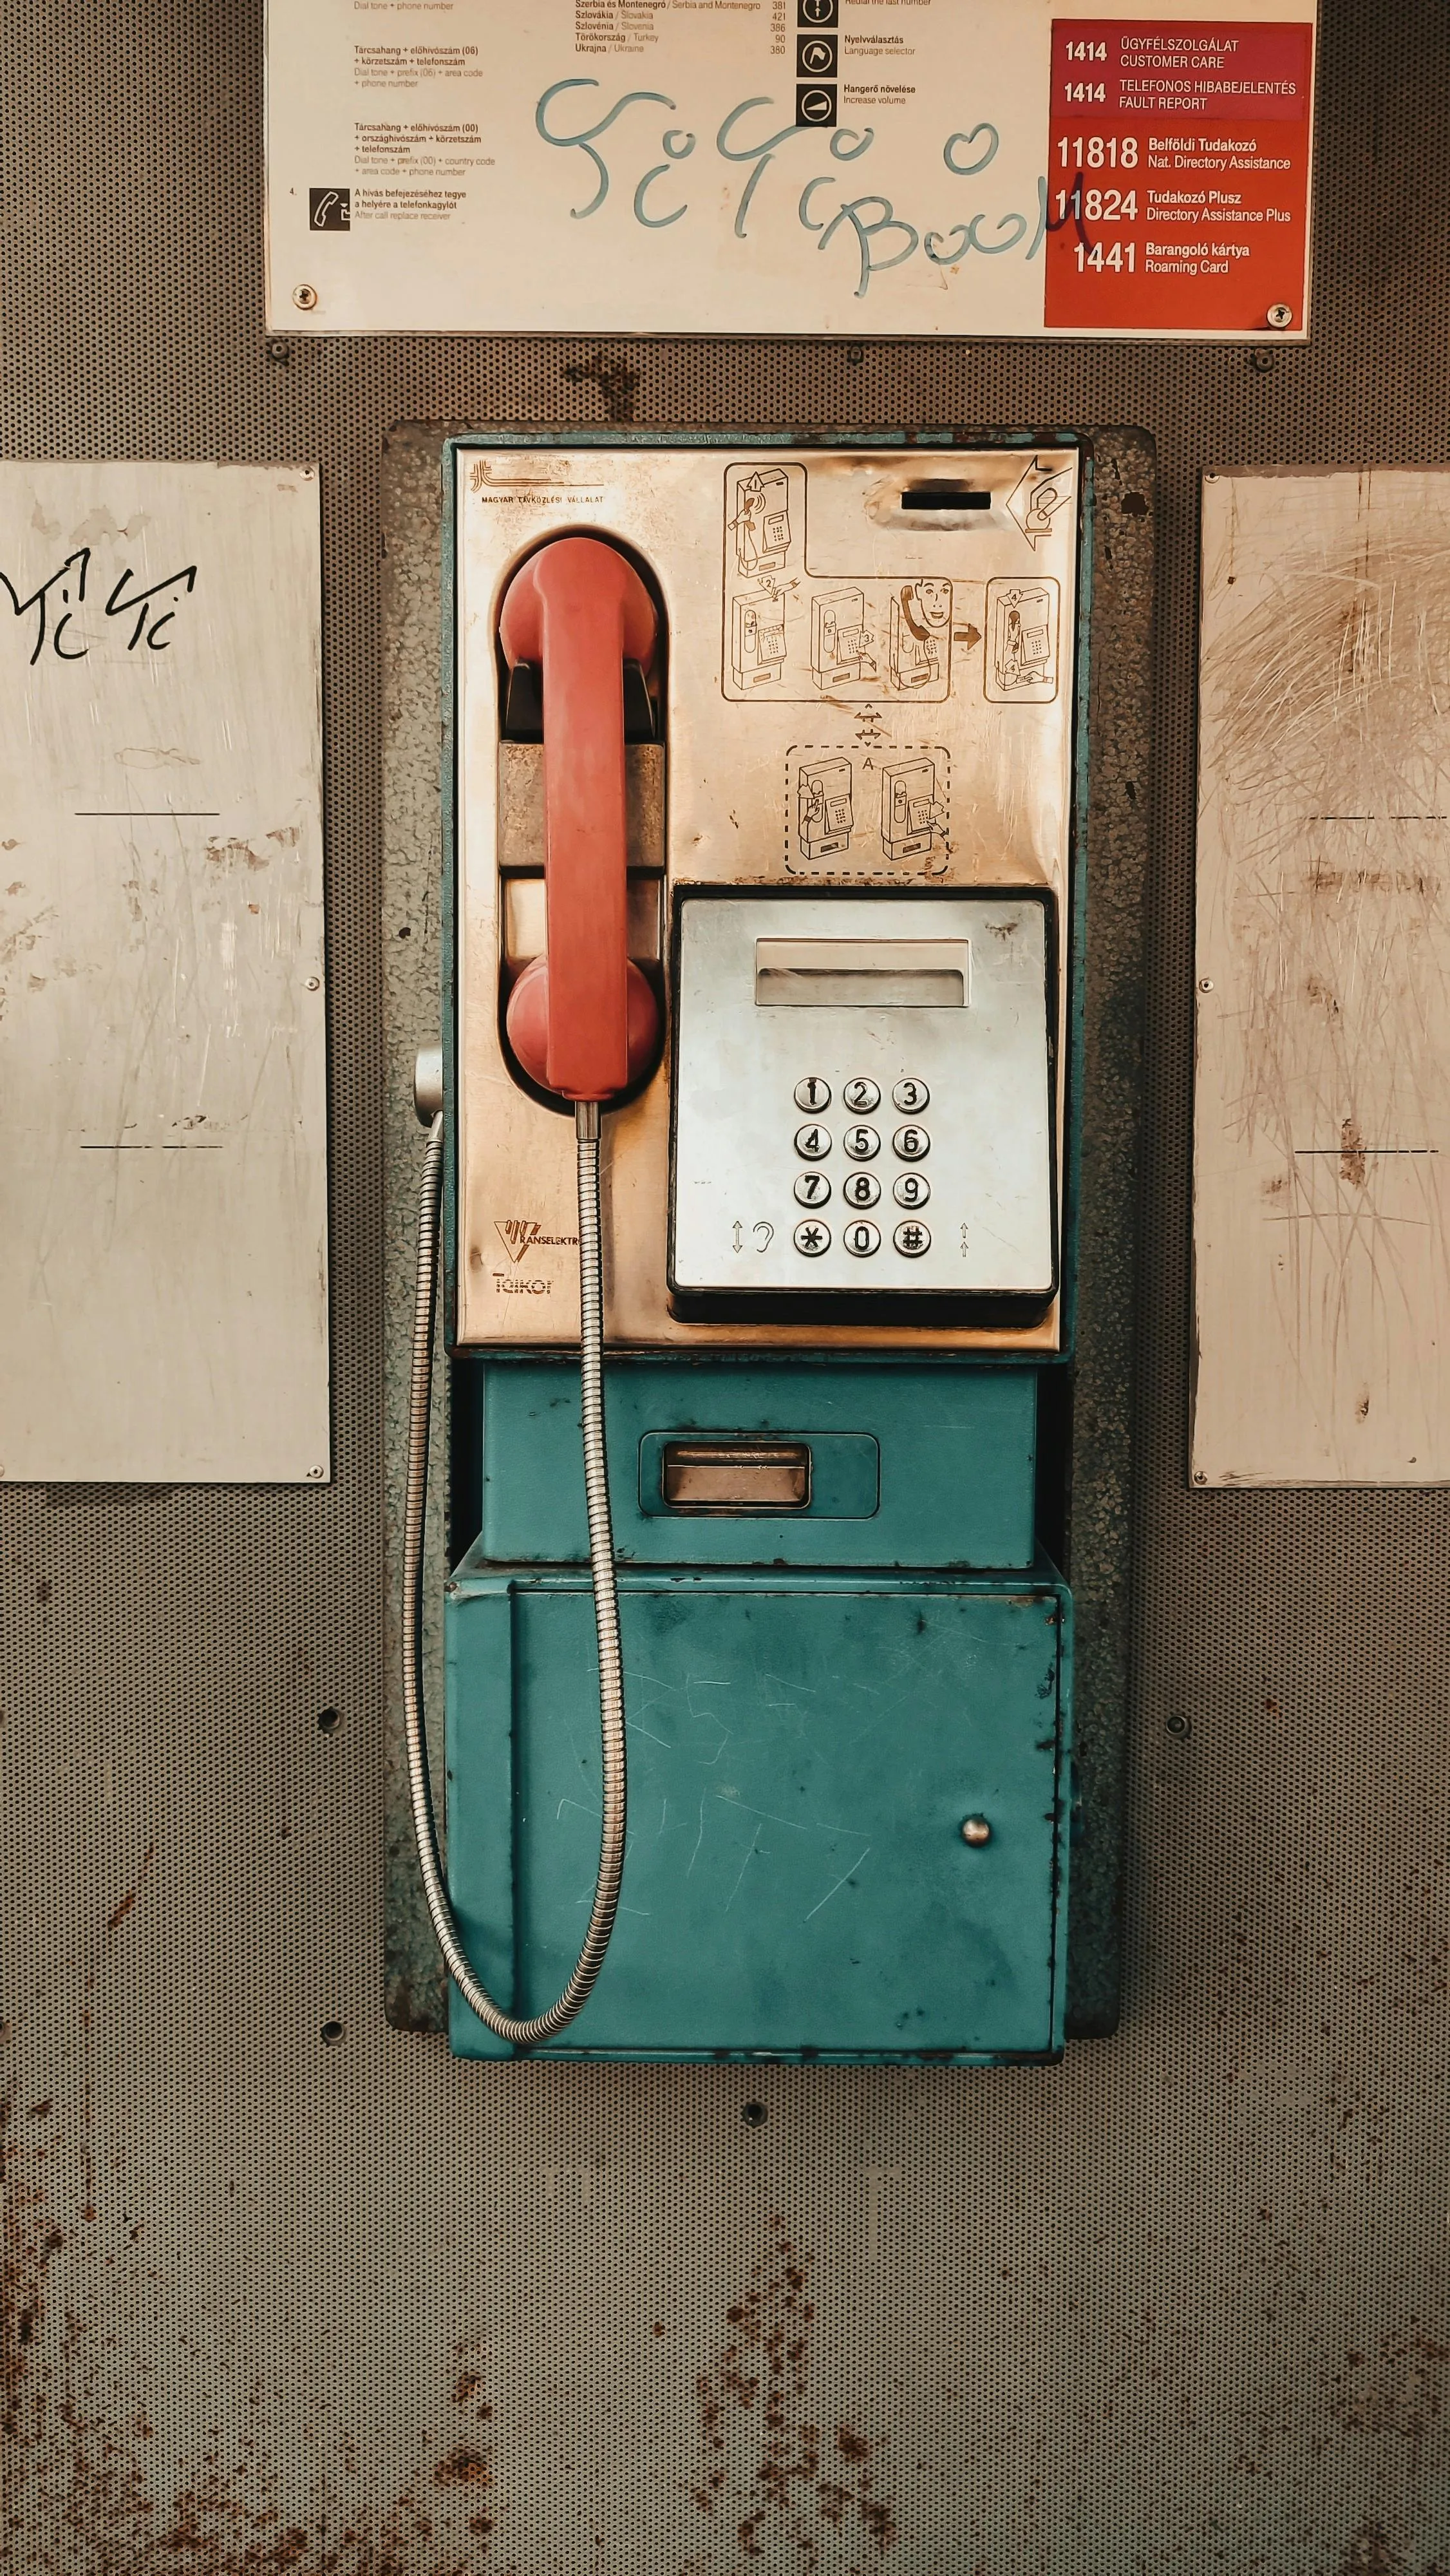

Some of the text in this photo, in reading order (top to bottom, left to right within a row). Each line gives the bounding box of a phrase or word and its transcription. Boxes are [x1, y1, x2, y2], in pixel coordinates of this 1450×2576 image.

[715, 1, 760, 11] Montenegro
[773, 1, 786, 10] 381
[576, 10, 614, 19] Szlovákia
[621, 11, 654, 19] Slovakia
[773, 13, 786, 21] 421
[576, 21, 614, 30] Szlovénia
[621, 22, 654, 30] Slovenia
[576, 33, 626, 43] Törökország
[634, 33, 659, 43] Turkey
[775, 35, 786, 43] 90
[845, 35, 904, 44] Nyelvválasztás
[1120, 36, 1239, 52] ÜGYFÉLSZOLGÁLAT
[462, 46, 478, 56] (06)
[576, 44, 607, 53] Ukrajna
[770, 46, 786, 54] 380
[845, 46, 883, 56] Language
[1066, 41, 1107, 61] 1414
[417, 57, 465, 66] telefonszám
[1120, 55, 1225, 68] CUSTOMER CARE
[354, 68, 369, 76] Dial
[397, 68, 418, 77] prefix
[362, 79, 386, 88] phone
[843, 84, 878, 94] Hangerő
[1120, 79, 1296, 95] TELEFONOS HIBABEJELENTÉS
[1064, 82, 1106, 102] 1414
[843, 95, 876, 104] Increase
[1119, 96, 1208, 110] FAULT REPORT
[462, 124, 478, 133] (00)
[362, 145, 410, 153] telefonszám
[1149, 137, 1257, 152] Belföldi Tudakozó
[1057, 137, 1138, 168] 11818
[397, 156, 418, 165] prefix
[445, 157, 474, 166] country
[1148, 155, 1291, 171] Nat. Directory Assistance
[409, 168, 433, 177] phone
[445, 191, 466, 200] tegye
[1147, 190, 1241, 204] Tudakozó Plusz
[362, 200, 391, 209] helyére
[1055, 189, 1138, 220] 11824
[390, 211, 419, 220] replace
[1147, 207, 1291, 223] Directory Assistance Plus
[1145, 242, 1250, 259] Barangoló kártya
[1074, 242, 1135, 273] 1441
[1145, 259, 1229, 275] Roaming Card
[862, 757, 873, 770] A
[807, 1079, 917, 1106] 1 2 3
[805, 1128, 918, 1153] 4 5 6
[804, 1175, 919, 1202] 7 8 9
[854, 1226, 869, 1249] 0
